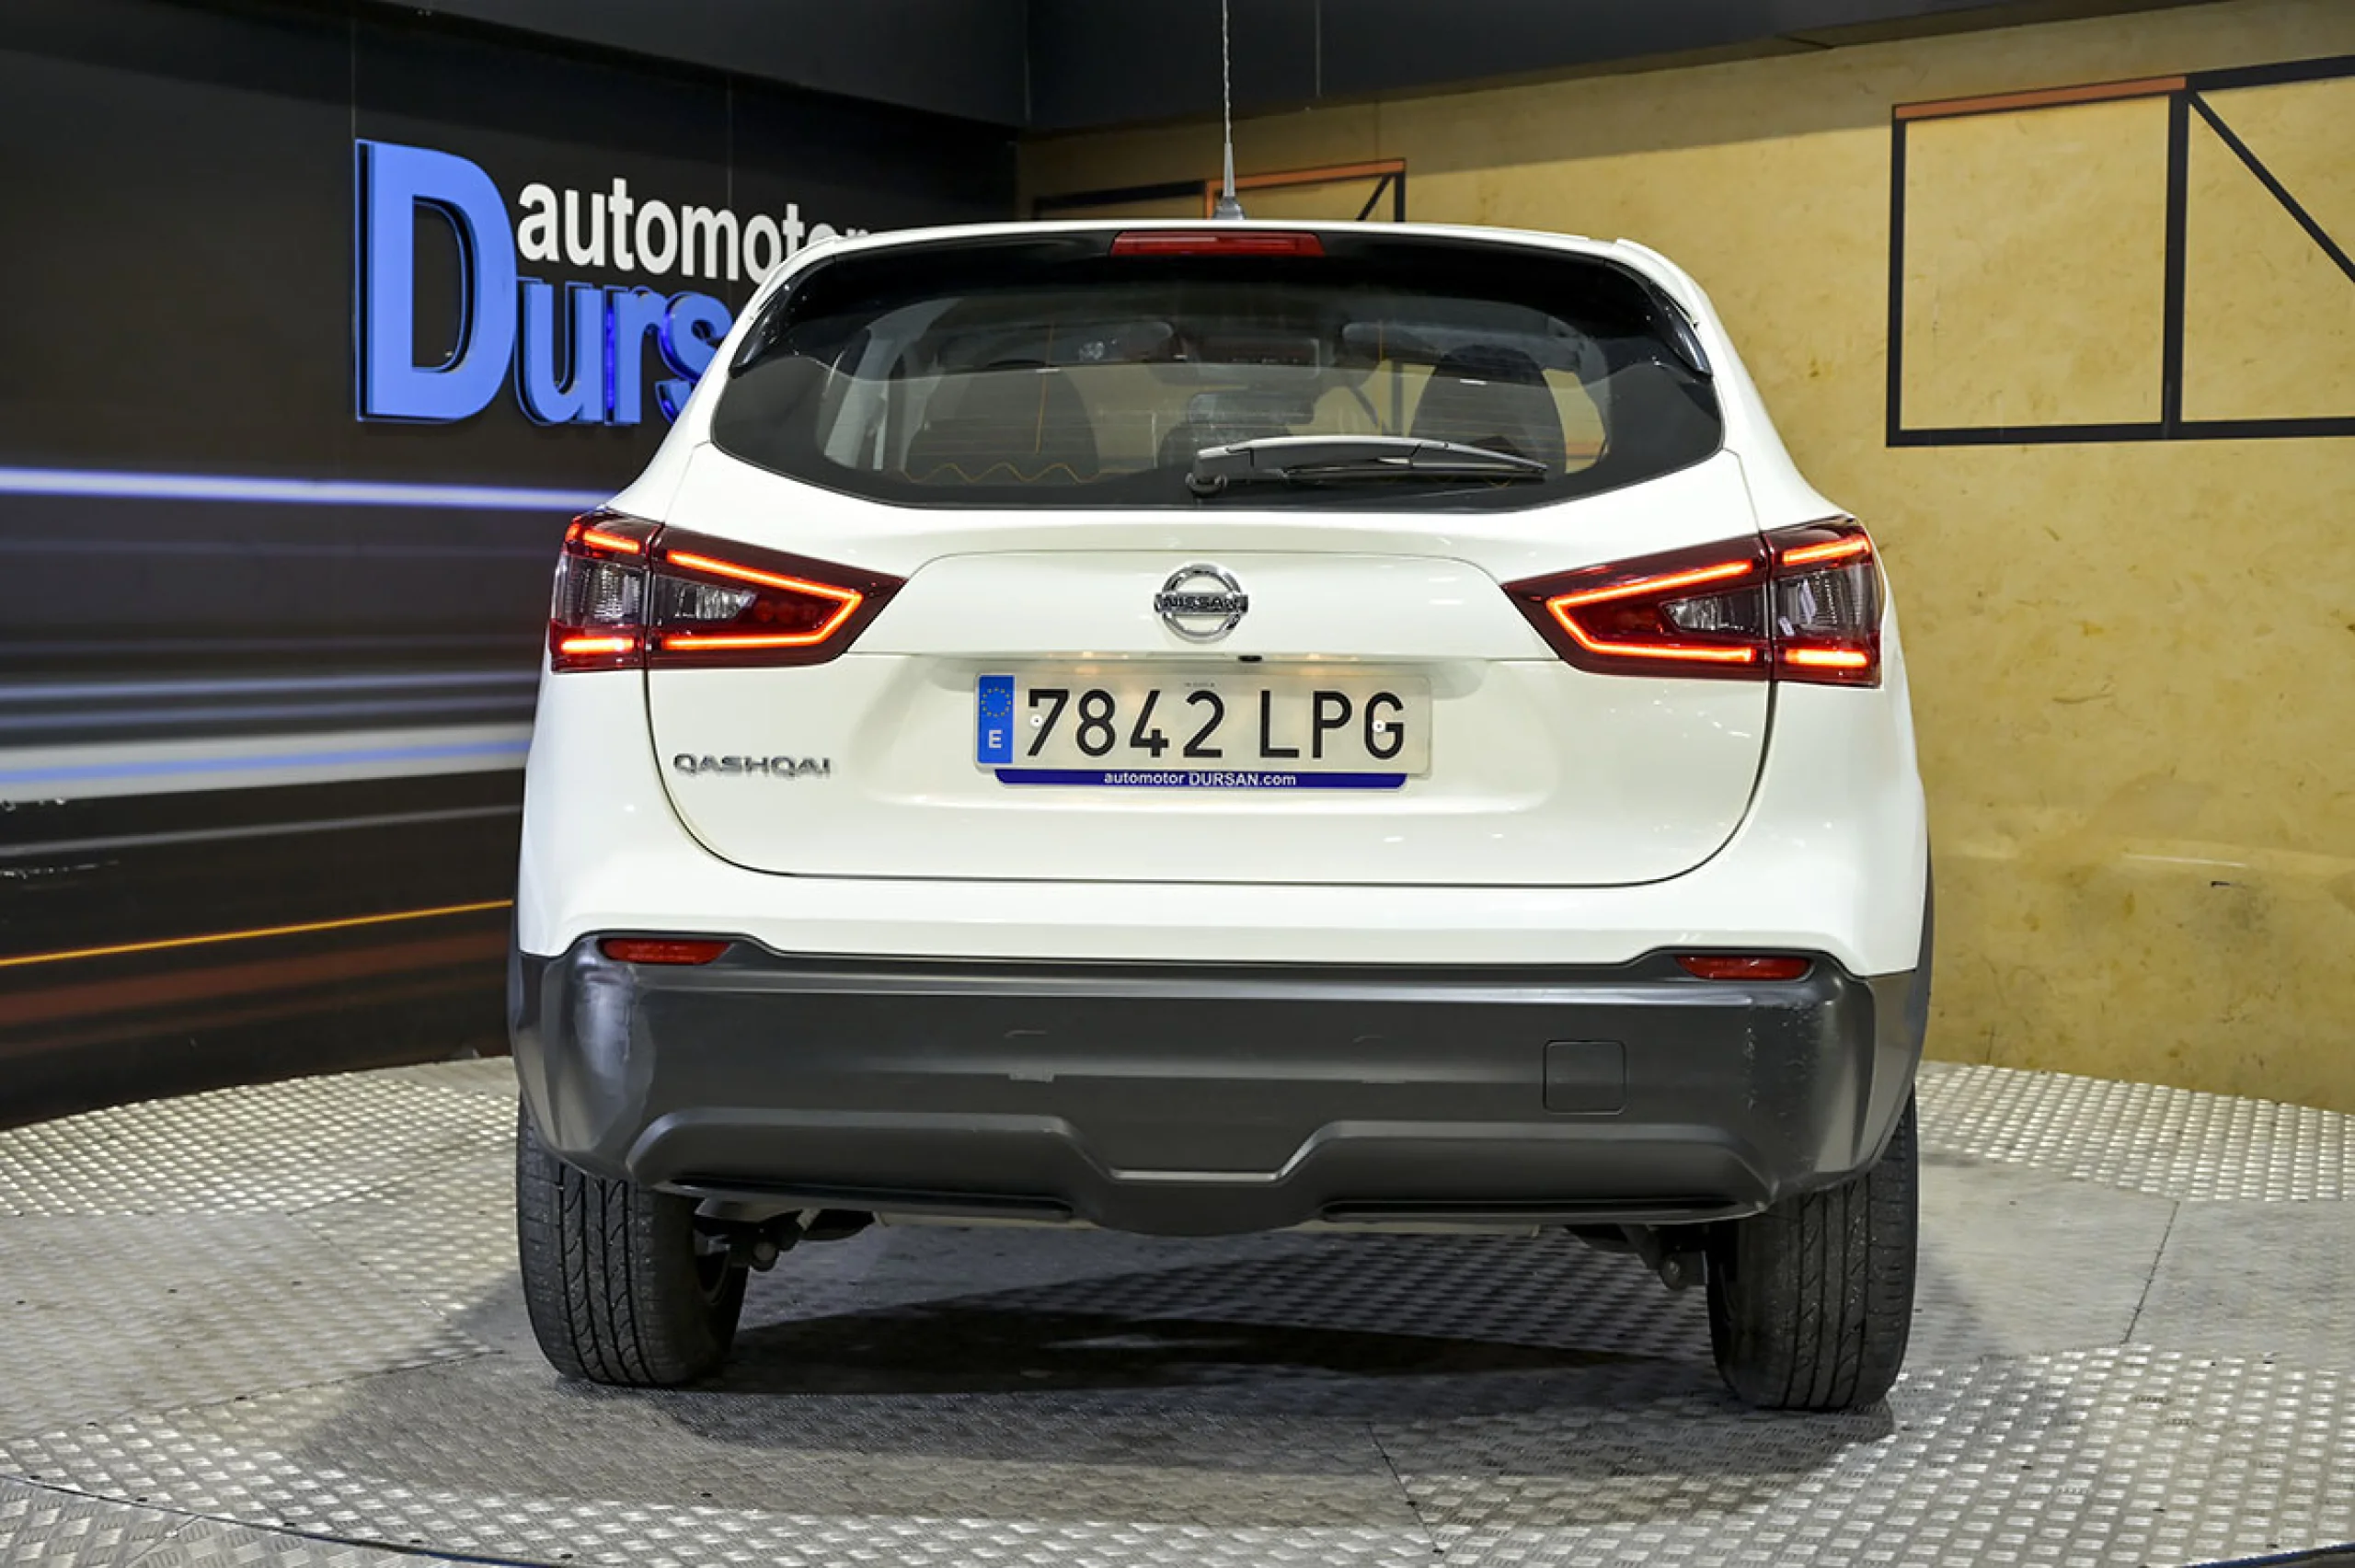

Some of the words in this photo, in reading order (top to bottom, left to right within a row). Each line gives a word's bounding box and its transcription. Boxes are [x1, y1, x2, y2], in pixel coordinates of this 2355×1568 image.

[517, 177, 870, 284] automot
[1026, 688, 1225, 760] 7842
[1259, 689, 1405, 761] LPG
[988, 729, 1003, 749] E
[672, 752, 833, 778] QASHQAI
[1104, 772, 1186, 785] automotor
[1188, 772, 1297, 786] DURSAN.com
